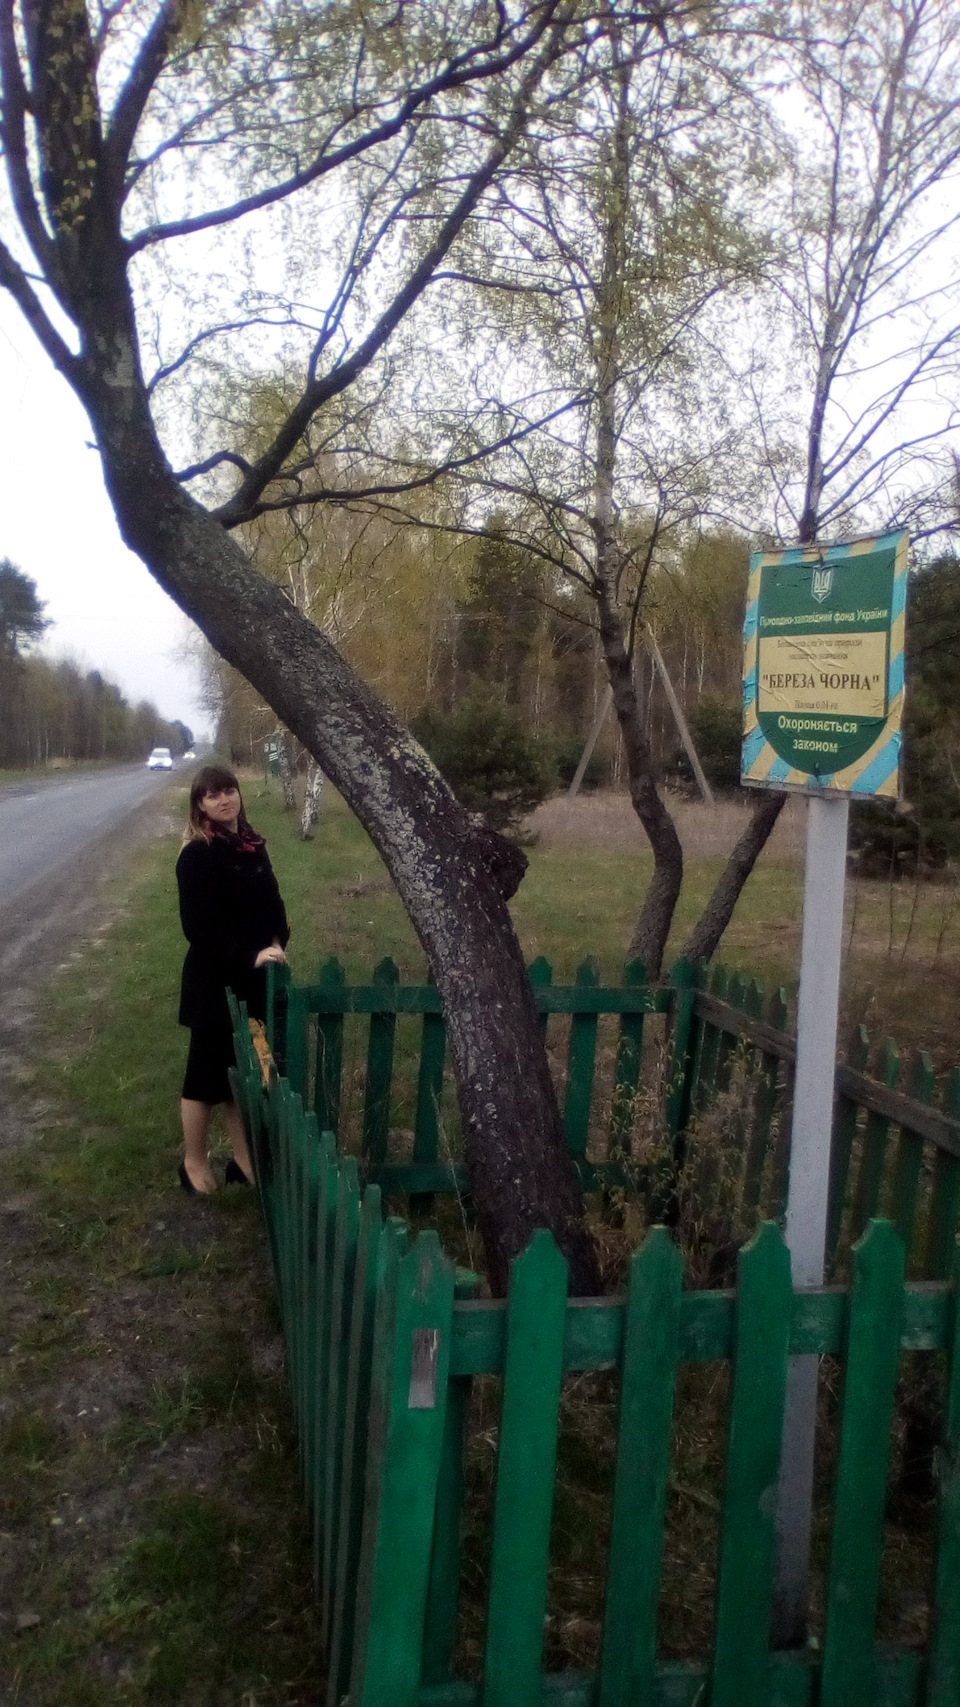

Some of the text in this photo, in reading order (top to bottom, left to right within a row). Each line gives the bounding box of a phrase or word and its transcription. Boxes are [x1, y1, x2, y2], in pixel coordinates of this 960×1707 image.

[834, 611, 855, 624] фонд
[857, 608, 888, 622] України
[763, 674, 880, 691] "БЕРЕЗА ЧОРНА"
[778, 715, 857, 734] Охороняється
[793, 739, 838, 753] законом
